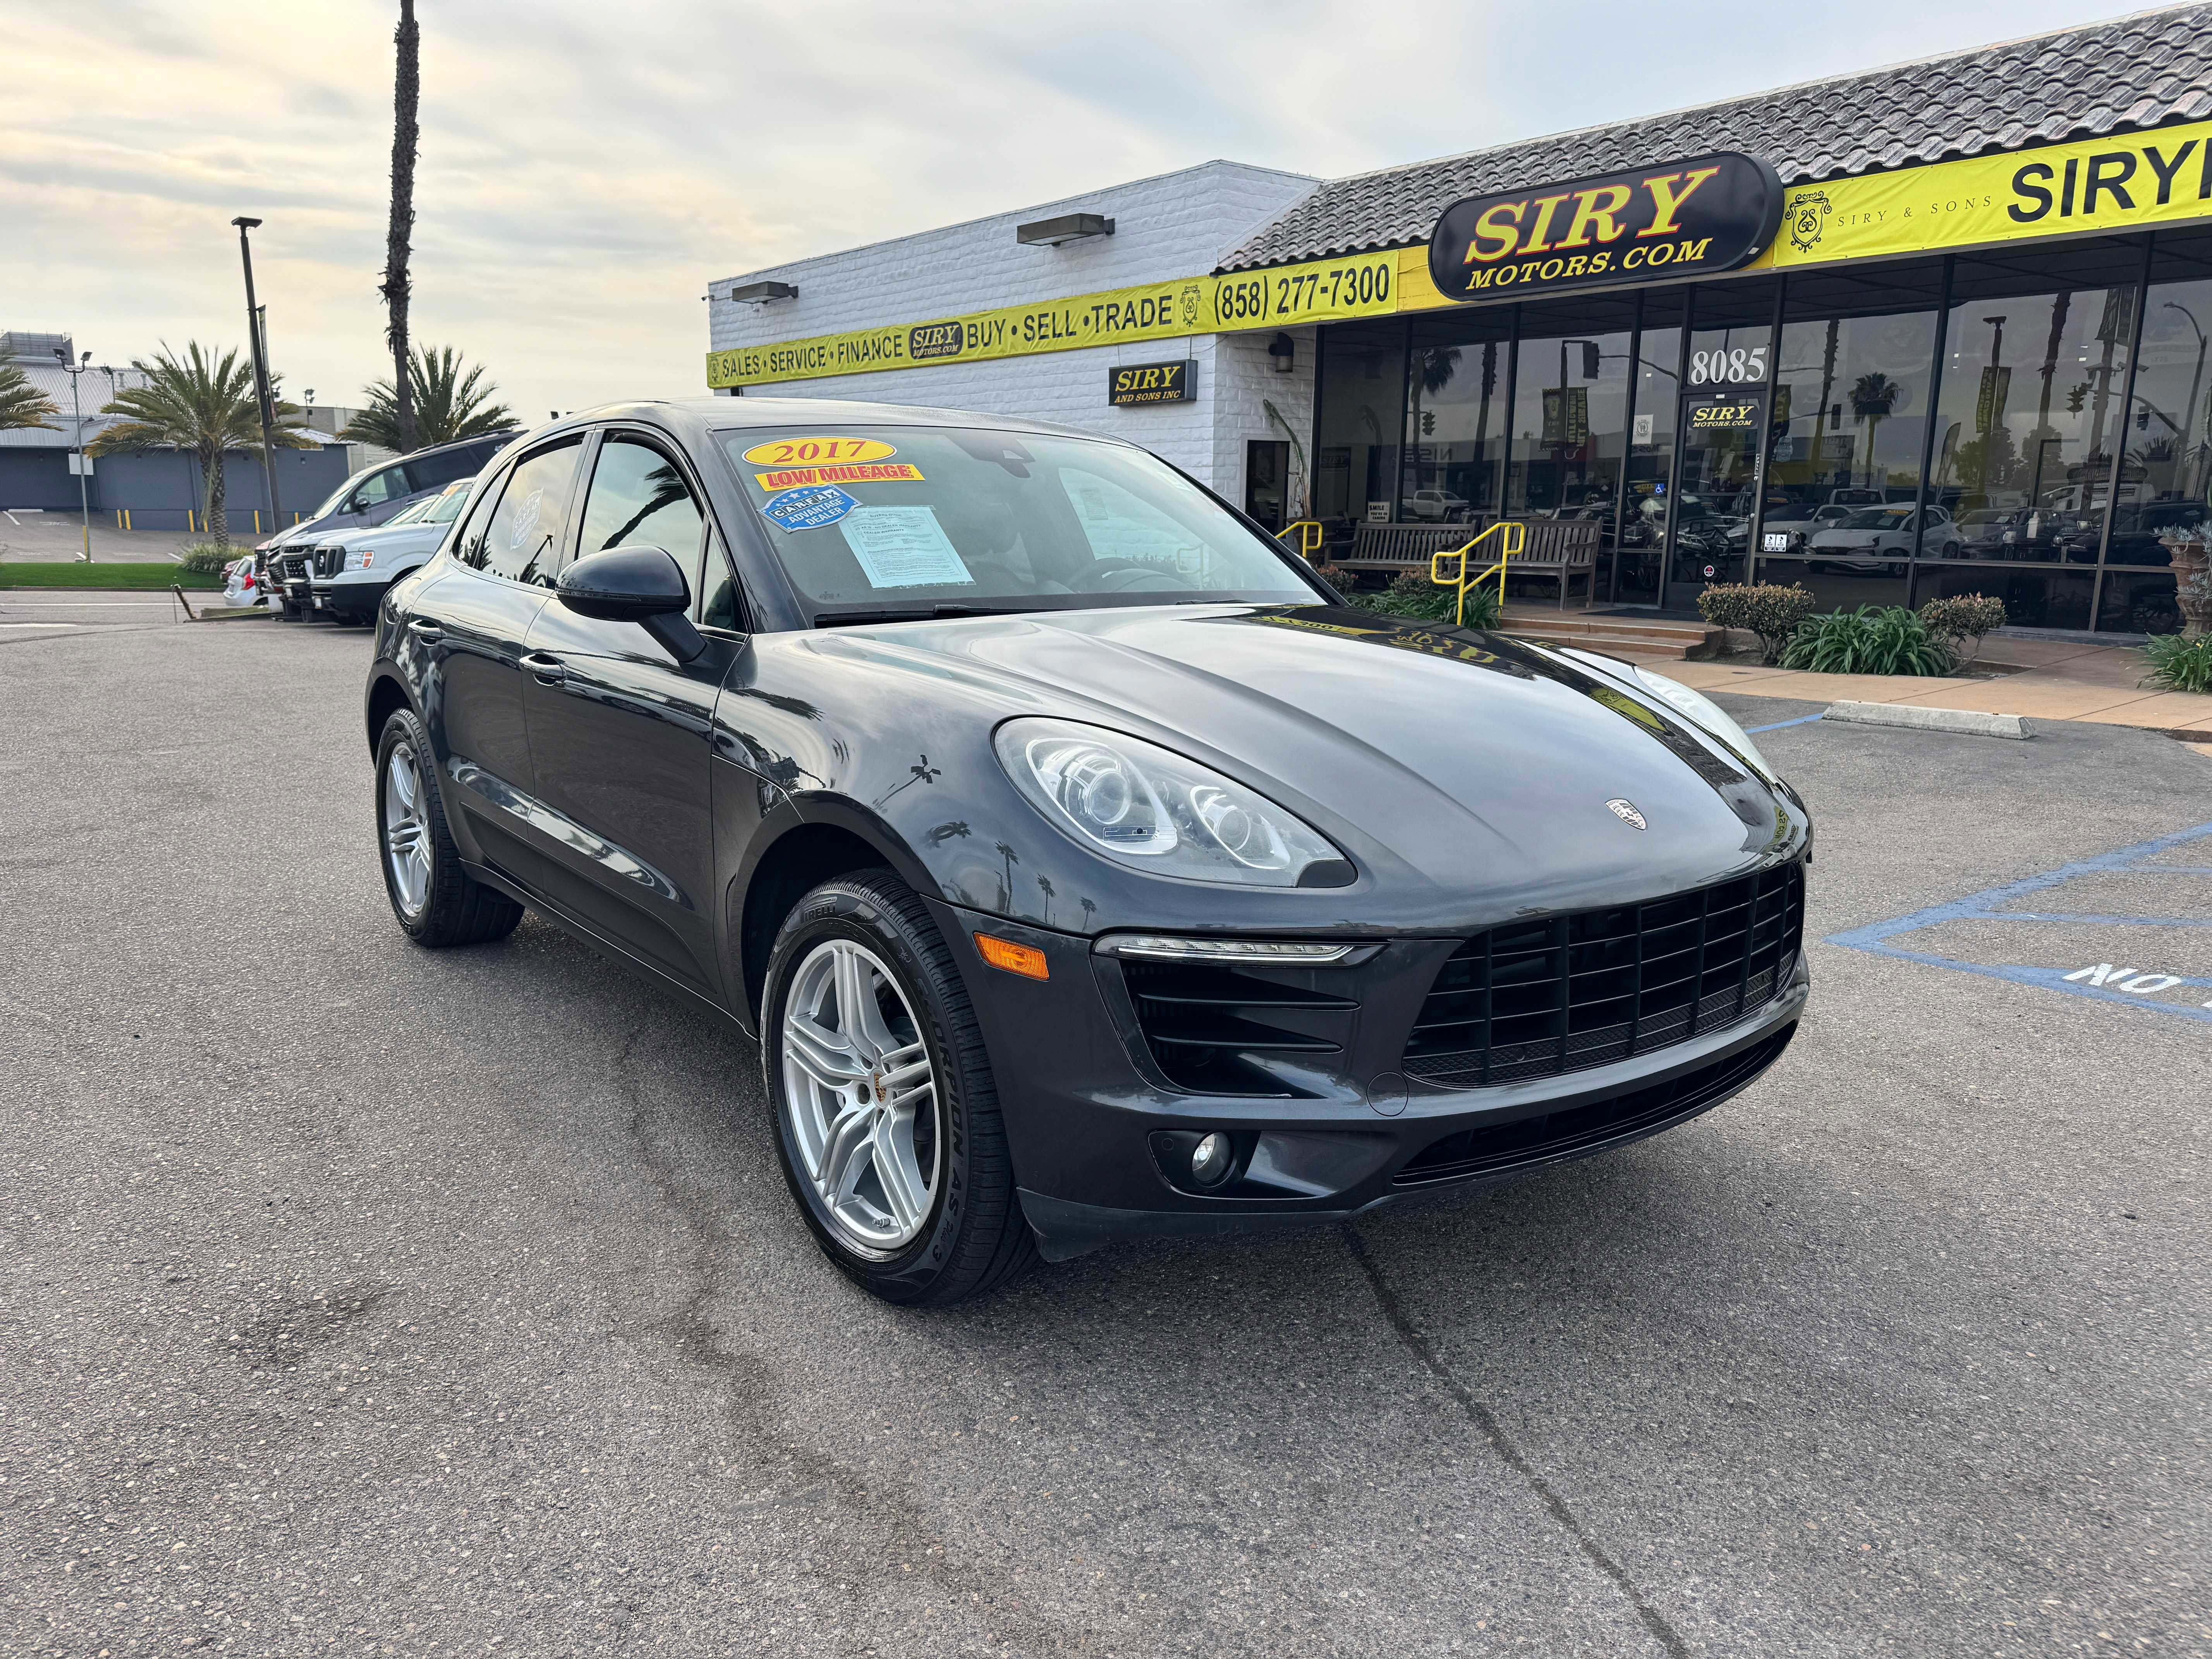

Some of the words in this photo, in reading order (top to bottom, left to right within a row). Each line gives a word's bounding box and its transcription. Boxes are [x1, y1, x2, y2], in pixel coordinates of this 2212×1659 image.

[1462, 165, 1721, 265] SIRY
[1837, 208, 1887, 228] SIRY
[1903, 206, 1913, 218] &
[1930, 195, 1993, 214] SONS
[1465, 237, 1713, 290] MOTORS.COM
[1214, 275, 1268, 325] (858)
[1277, 264, 1389, 314] 277-7300
[967, 318, 1006, 349] BUY
[1024, 310, 1077, 342] SELL
[1091, 295, 1172, 333] TRADE
[913, 325, 959, 348] SIRY
[722, 355, 759, 378] SALES
[770, 346, 825, 373] SERVICE
[838, 334, 902, 364] FINANCE
[914, 345, 959, 356] MOTORS.COM
[1115, 366, 1180, 392] SIRY
[1691, 348, 1766, 384] 8085
[1114, 394, 1134, 403] AND
[1135, 392, 1161, 401] SONS
[1162, 390, 1181, 399] INC
[1693, 406, 1754, 421] SIRY
[773, 441, 866, 463] 2017
[766, 467, 816, 488] LOW
[819, 465, 914, 481] MILEAGE
[775, 491, 837, 517] CARFAX
[788, 498, 845, 523] ADVANTAGE
[805, 507, 845, 525] DEALER
[2062, 963, 2181, 993] NO
